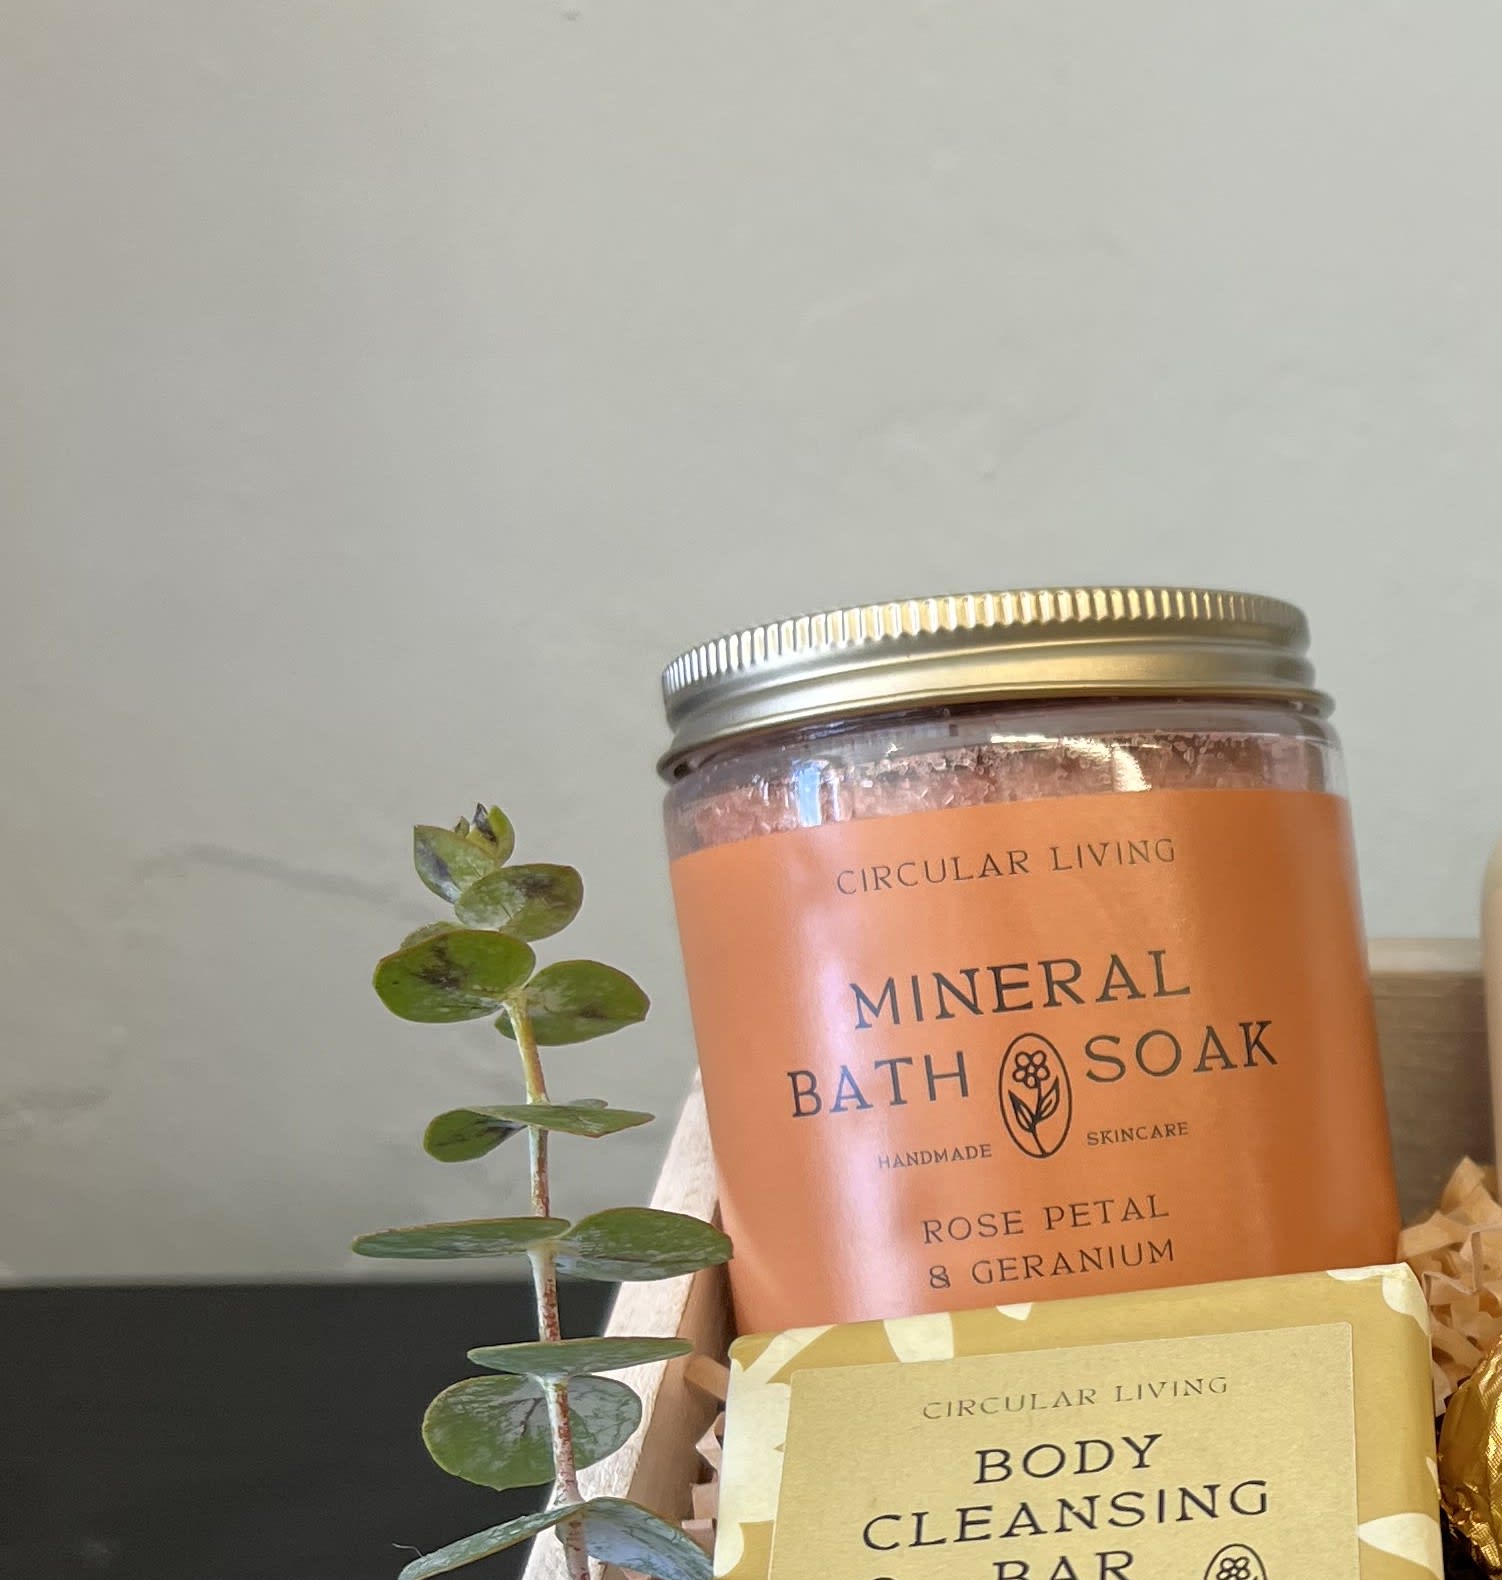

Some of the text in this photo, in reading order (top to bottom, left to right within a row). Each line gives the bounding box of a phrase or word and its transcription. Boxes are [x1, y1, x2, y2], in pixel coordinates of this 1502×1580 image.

[836, 837, 1176, 895] CIRCULAR LIVING
[850, 949, 1191, 1029] MINERAL
[787, 1020, 1278, 1118] BATH SOAK
[878, 1121, 1189, 1170] HANDMADE SKINCARE
[921, 1194, 1170, 1245] ROSE PETAL
[929, 1238, 1175, 1289] & GERANIUM
[922, 1376, 1228, 1421] CIRCULAR LIVING
[973, 1434, 1162, 1485] BODY
[862, 1479, 1269, 1552] CLEANSING
